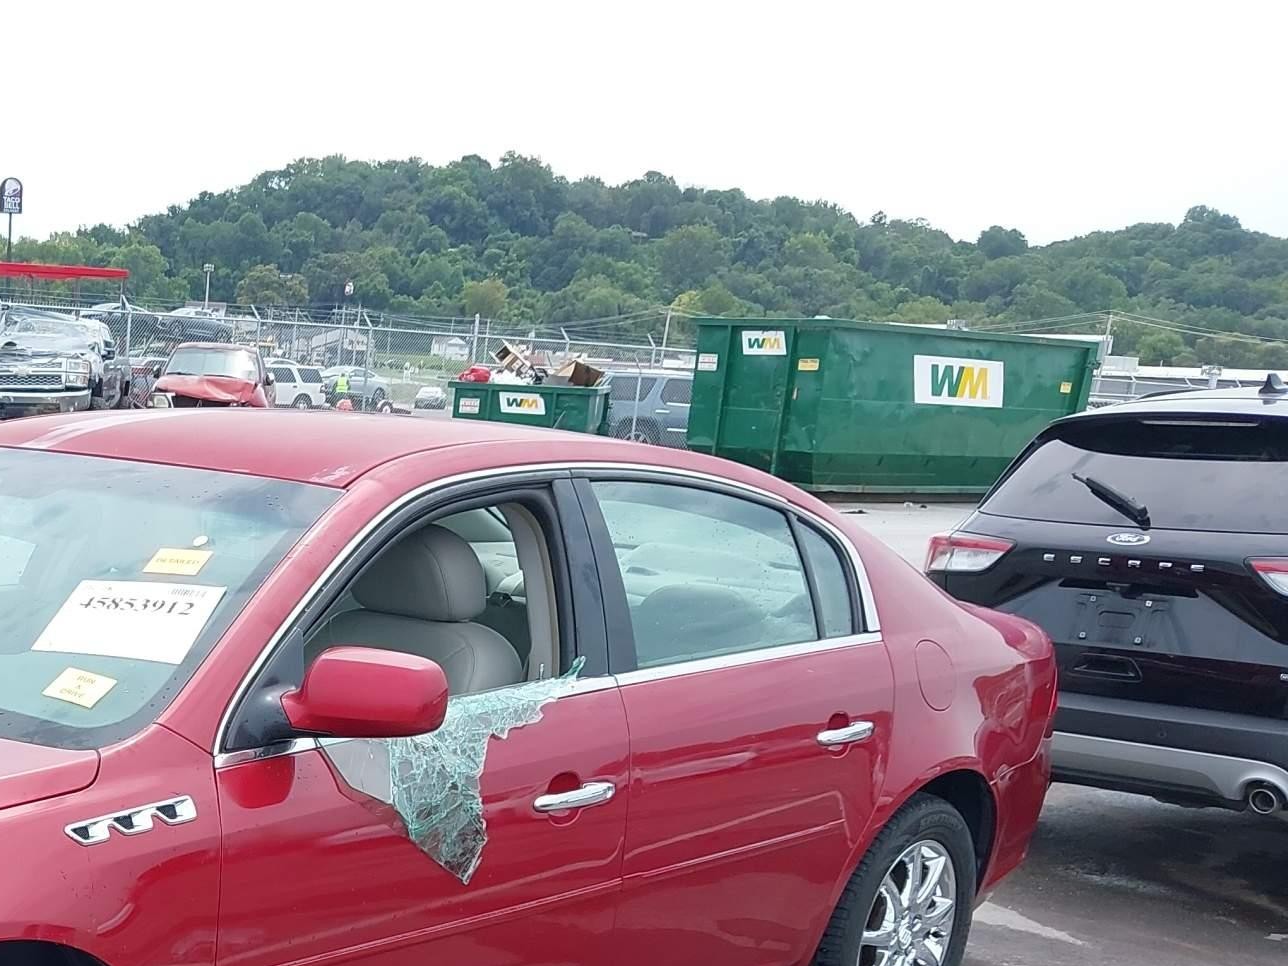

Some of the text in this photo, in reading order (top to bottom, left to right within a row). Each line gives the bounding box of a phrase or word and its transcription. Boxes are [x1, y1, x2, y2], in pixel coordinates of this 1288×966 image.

[747, 338, 781, 349] WM
[931, 364, 989, 400] WM
[506, 397, 539, 409] WM
[1043, 553, 1205, 572] ESCAPE
[79, 597, 195, 616] 45853912
